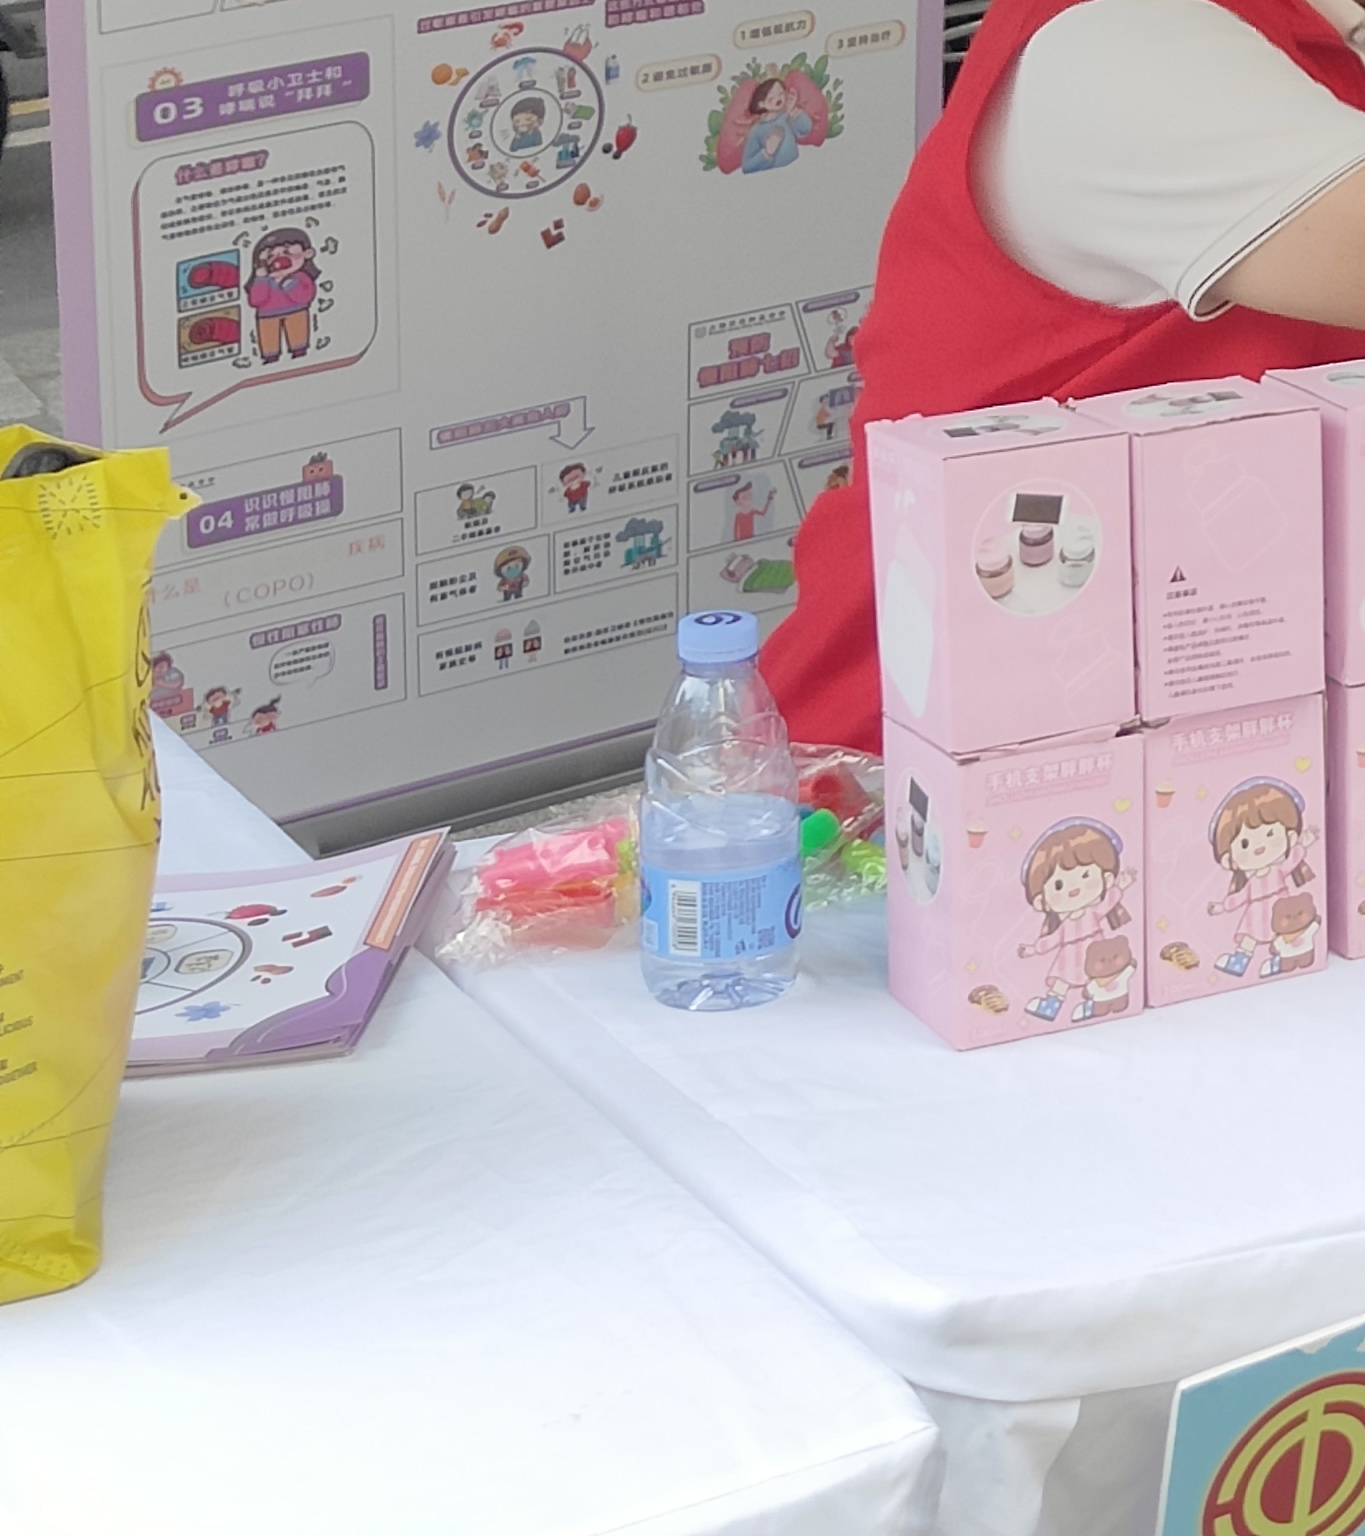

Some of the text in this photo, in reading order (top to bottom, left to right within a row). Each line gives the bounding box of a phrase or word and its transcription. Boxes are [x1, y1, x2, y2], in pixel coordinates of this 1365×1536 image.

[153, 66, 342, 125] 03 呼吸小卫士和
[199, 510, 234, 535] 04
[1172, 713, 1295, 753] 手机支架胖胖杯
